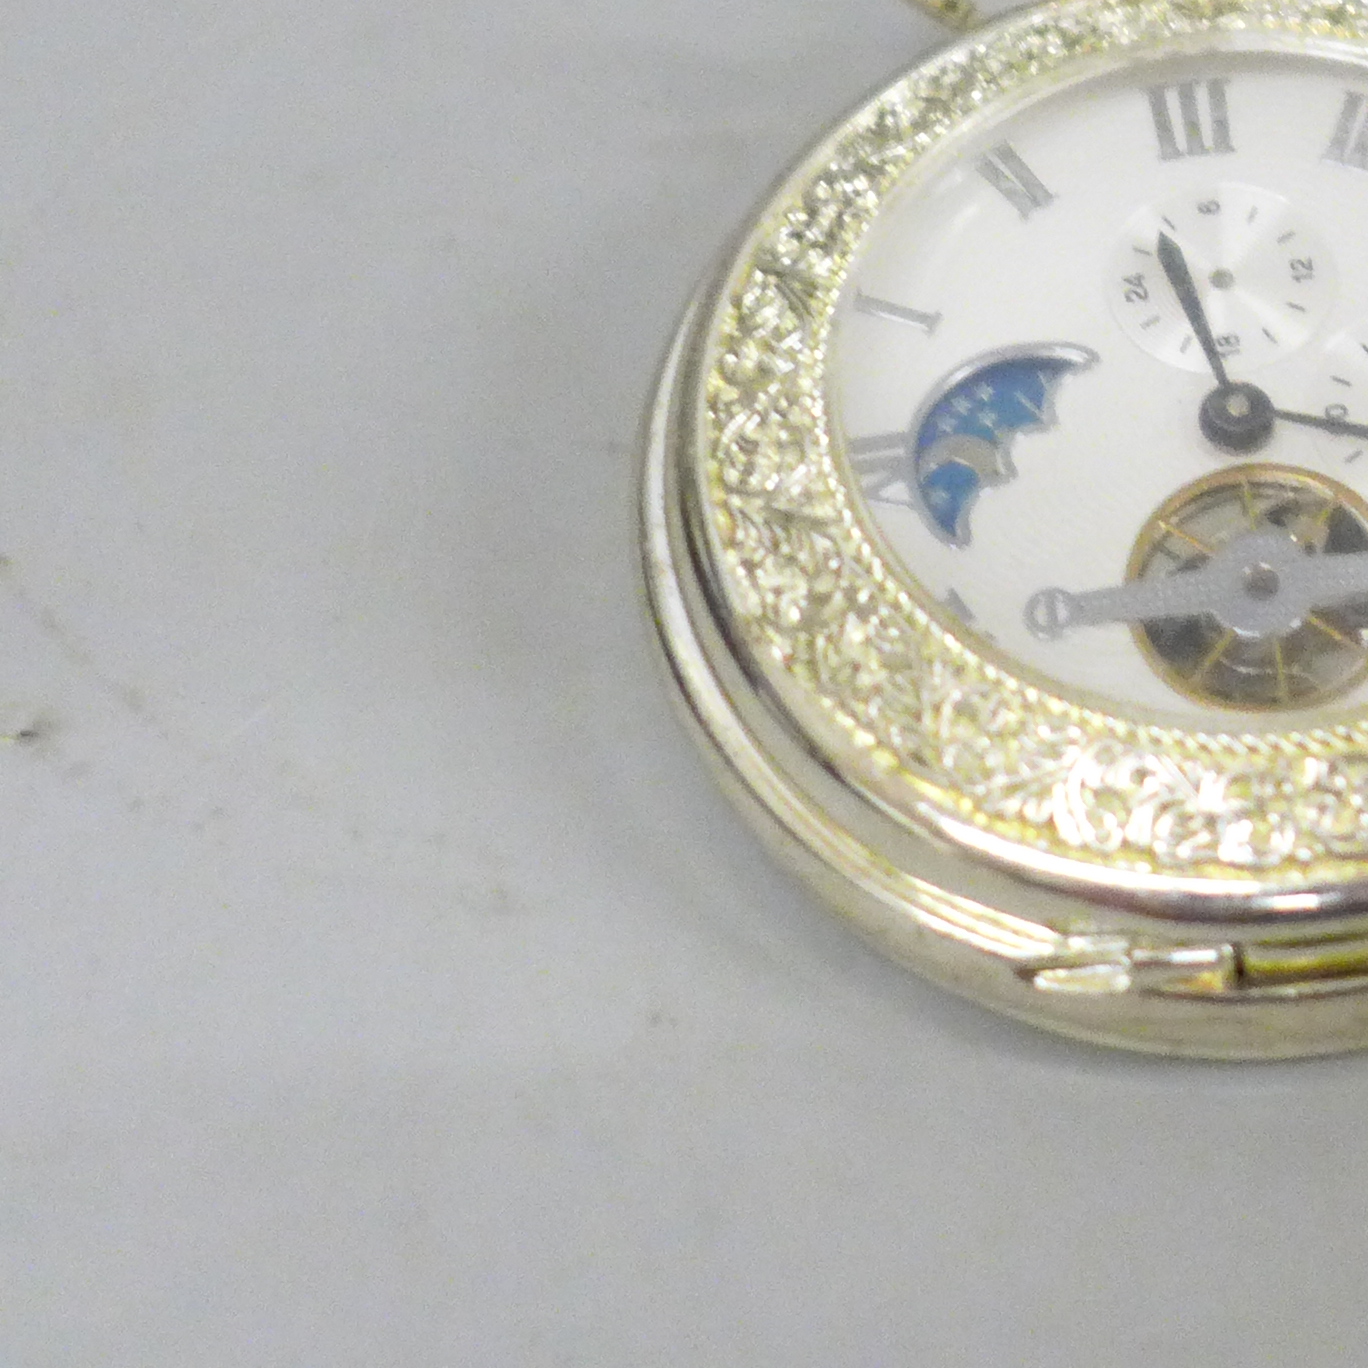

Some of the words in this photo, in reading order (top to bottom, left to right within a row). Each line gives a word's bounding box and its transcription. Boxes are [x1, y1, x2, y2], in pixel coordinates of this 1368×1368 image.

[1142, 78, 1236, 162] III
[1288, 256, 1315, 283] 12
[1121, 271, 1149, 303] 24
